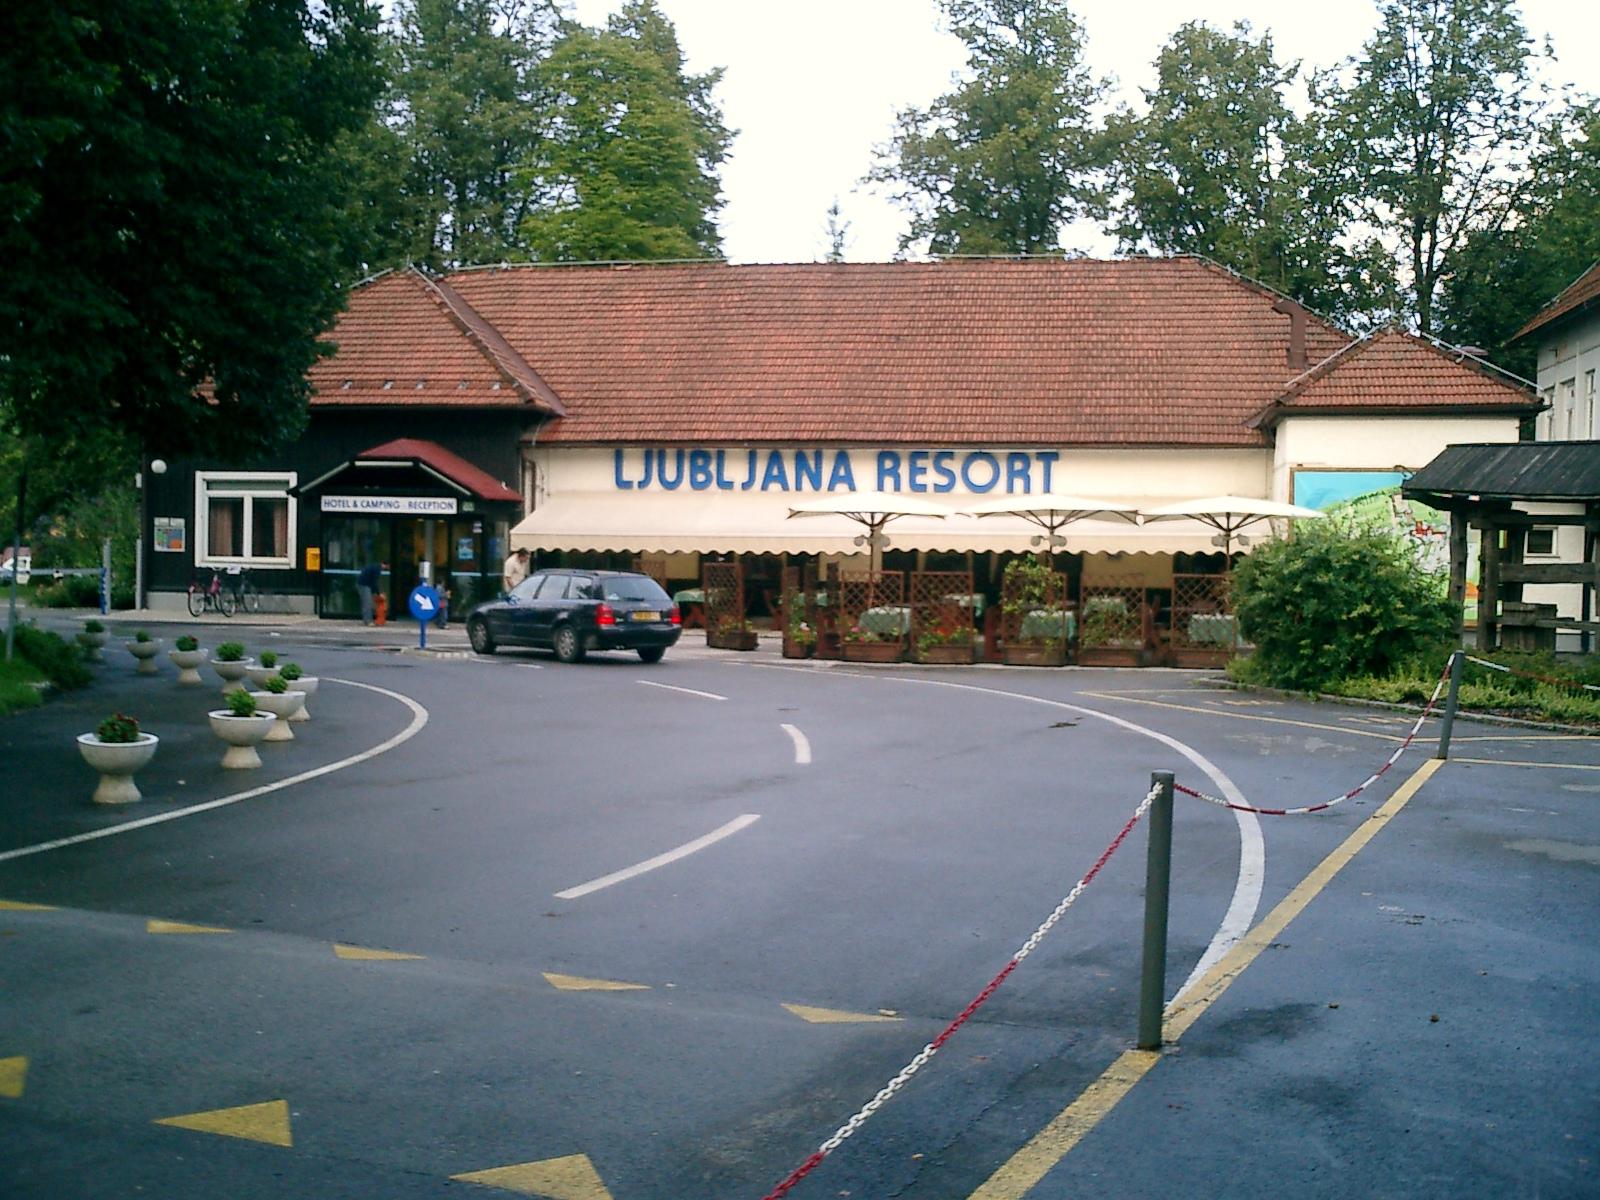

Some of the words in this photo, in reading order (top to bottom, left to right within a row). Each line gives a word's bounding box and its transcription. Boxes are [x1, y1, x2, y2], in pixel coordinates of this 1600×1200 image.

[614, 448, 857, 492] LJUBLJANA
[876, 450, 1060, 494] RESORT
[323, 498, 350, 508] HOTEL
[352, 500, 358, 508] &
[360, 499, 400, 509] CAMPING
[408, 501, 454, 510] RECEPTION
